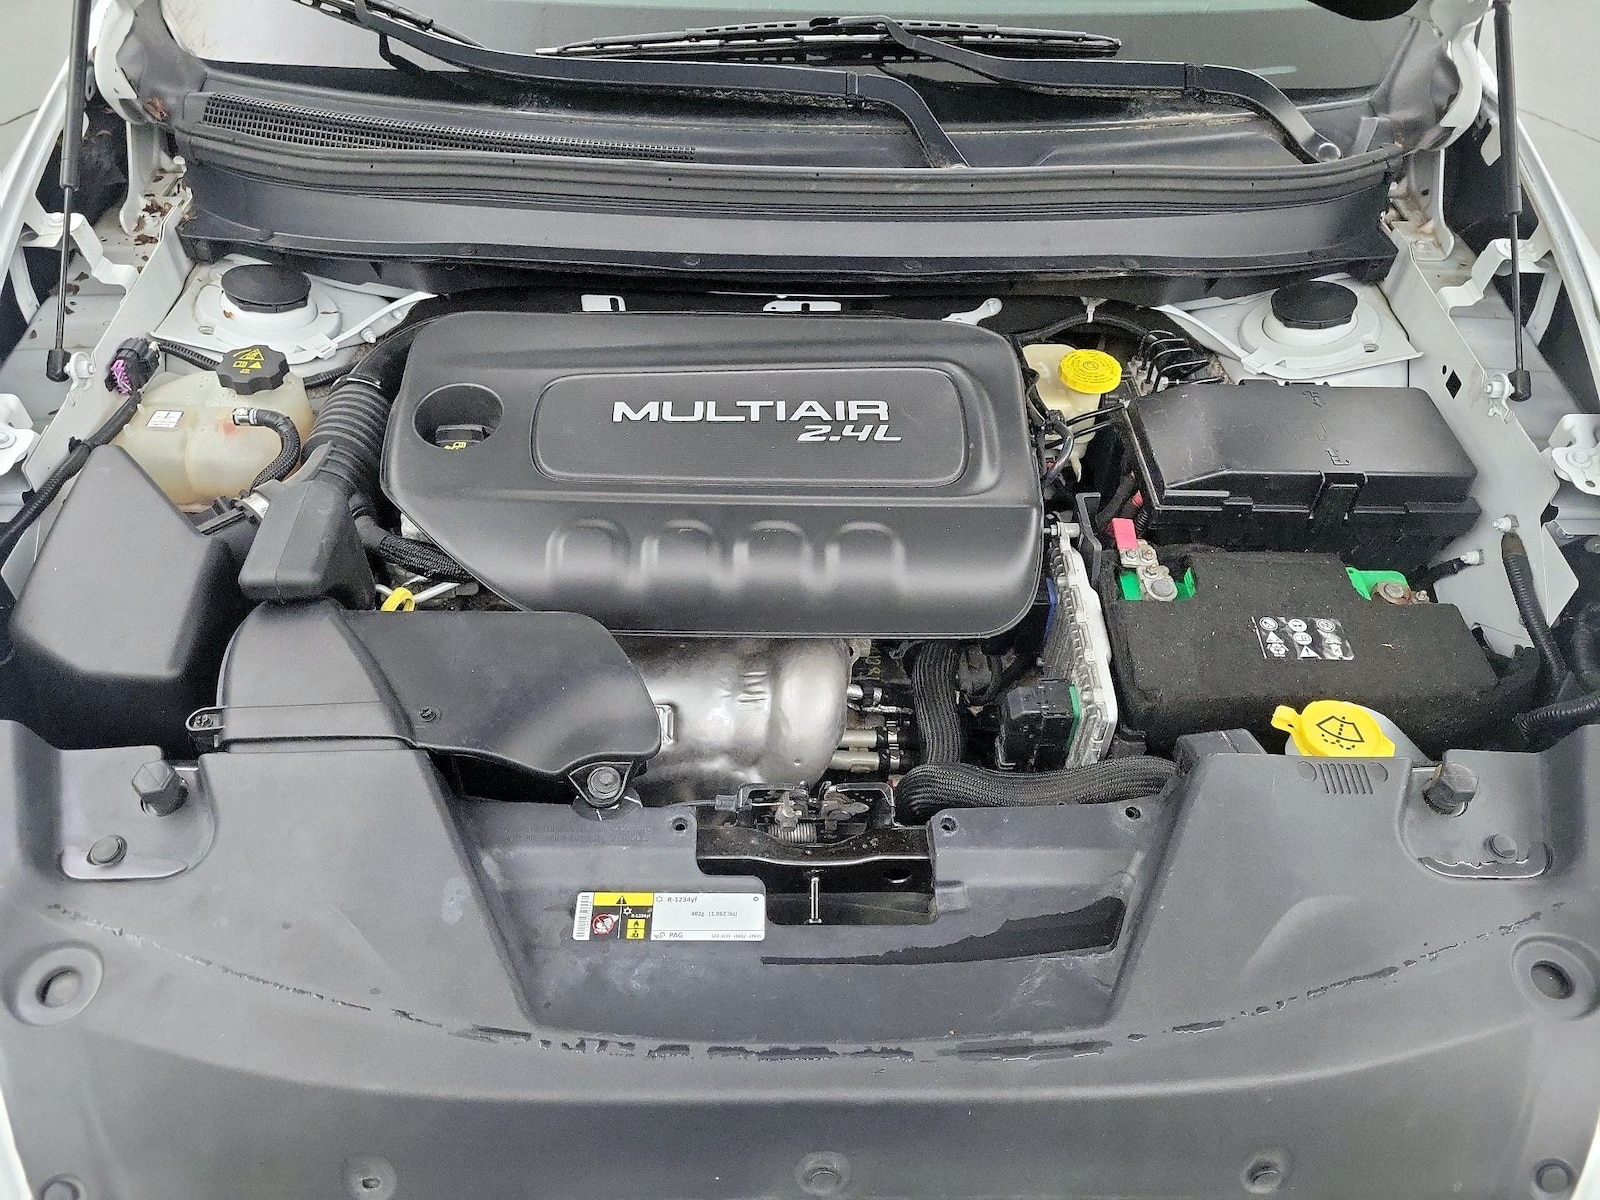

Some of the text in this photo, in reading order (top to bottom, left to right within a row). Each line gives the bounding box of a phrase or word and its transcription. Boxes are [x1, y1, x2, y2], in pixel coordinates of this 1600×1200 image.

[612, 400, 890, 423] MULTIAIR
[797, 424, 903, 443] 2.4L
[667, 896, 698, 904] R-1234yf
